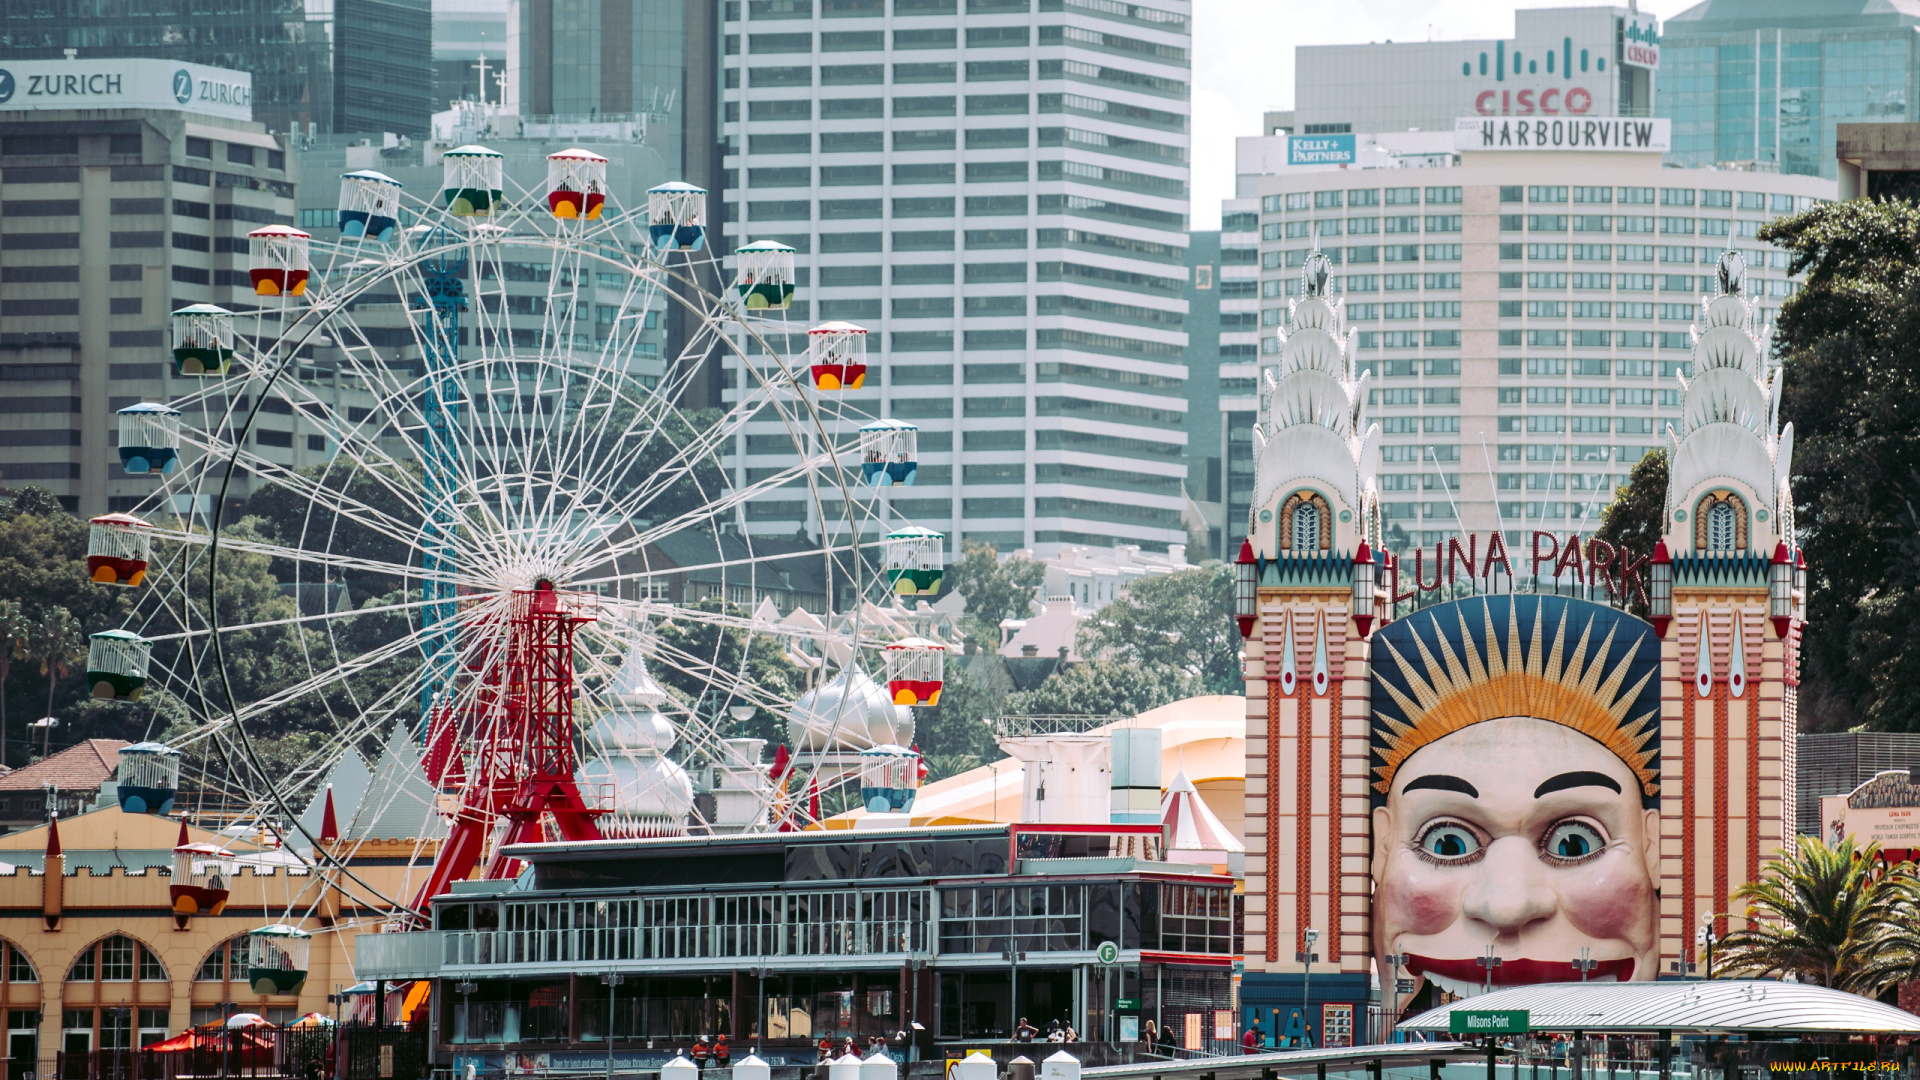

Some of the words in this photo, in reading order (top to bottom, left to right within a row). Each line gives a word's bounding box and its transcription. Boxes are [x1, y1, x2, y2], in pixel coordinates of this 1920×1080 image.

[1628, 45, 1657, 65] CISCO
[28, 74, 122, 96] ZURICH
[199, 80, 250, 106] ZURICH
[1475, 87, 1592, 116] CISCO
[1481, 120, 1653, 147] HARBOURVIEW
[1292, 139, 1329, 151] KELLY
[1292, 151, 1351, 162] PARTNERS
[1391, 530, 1513, 604] LUNA
[1532, 530, 1649, 606] PARK
[1105, 947, 1113, 959] F
[1467, 1015, 1491, 1028] Milsons
[1492, 1014, 1509, 1028] Point
